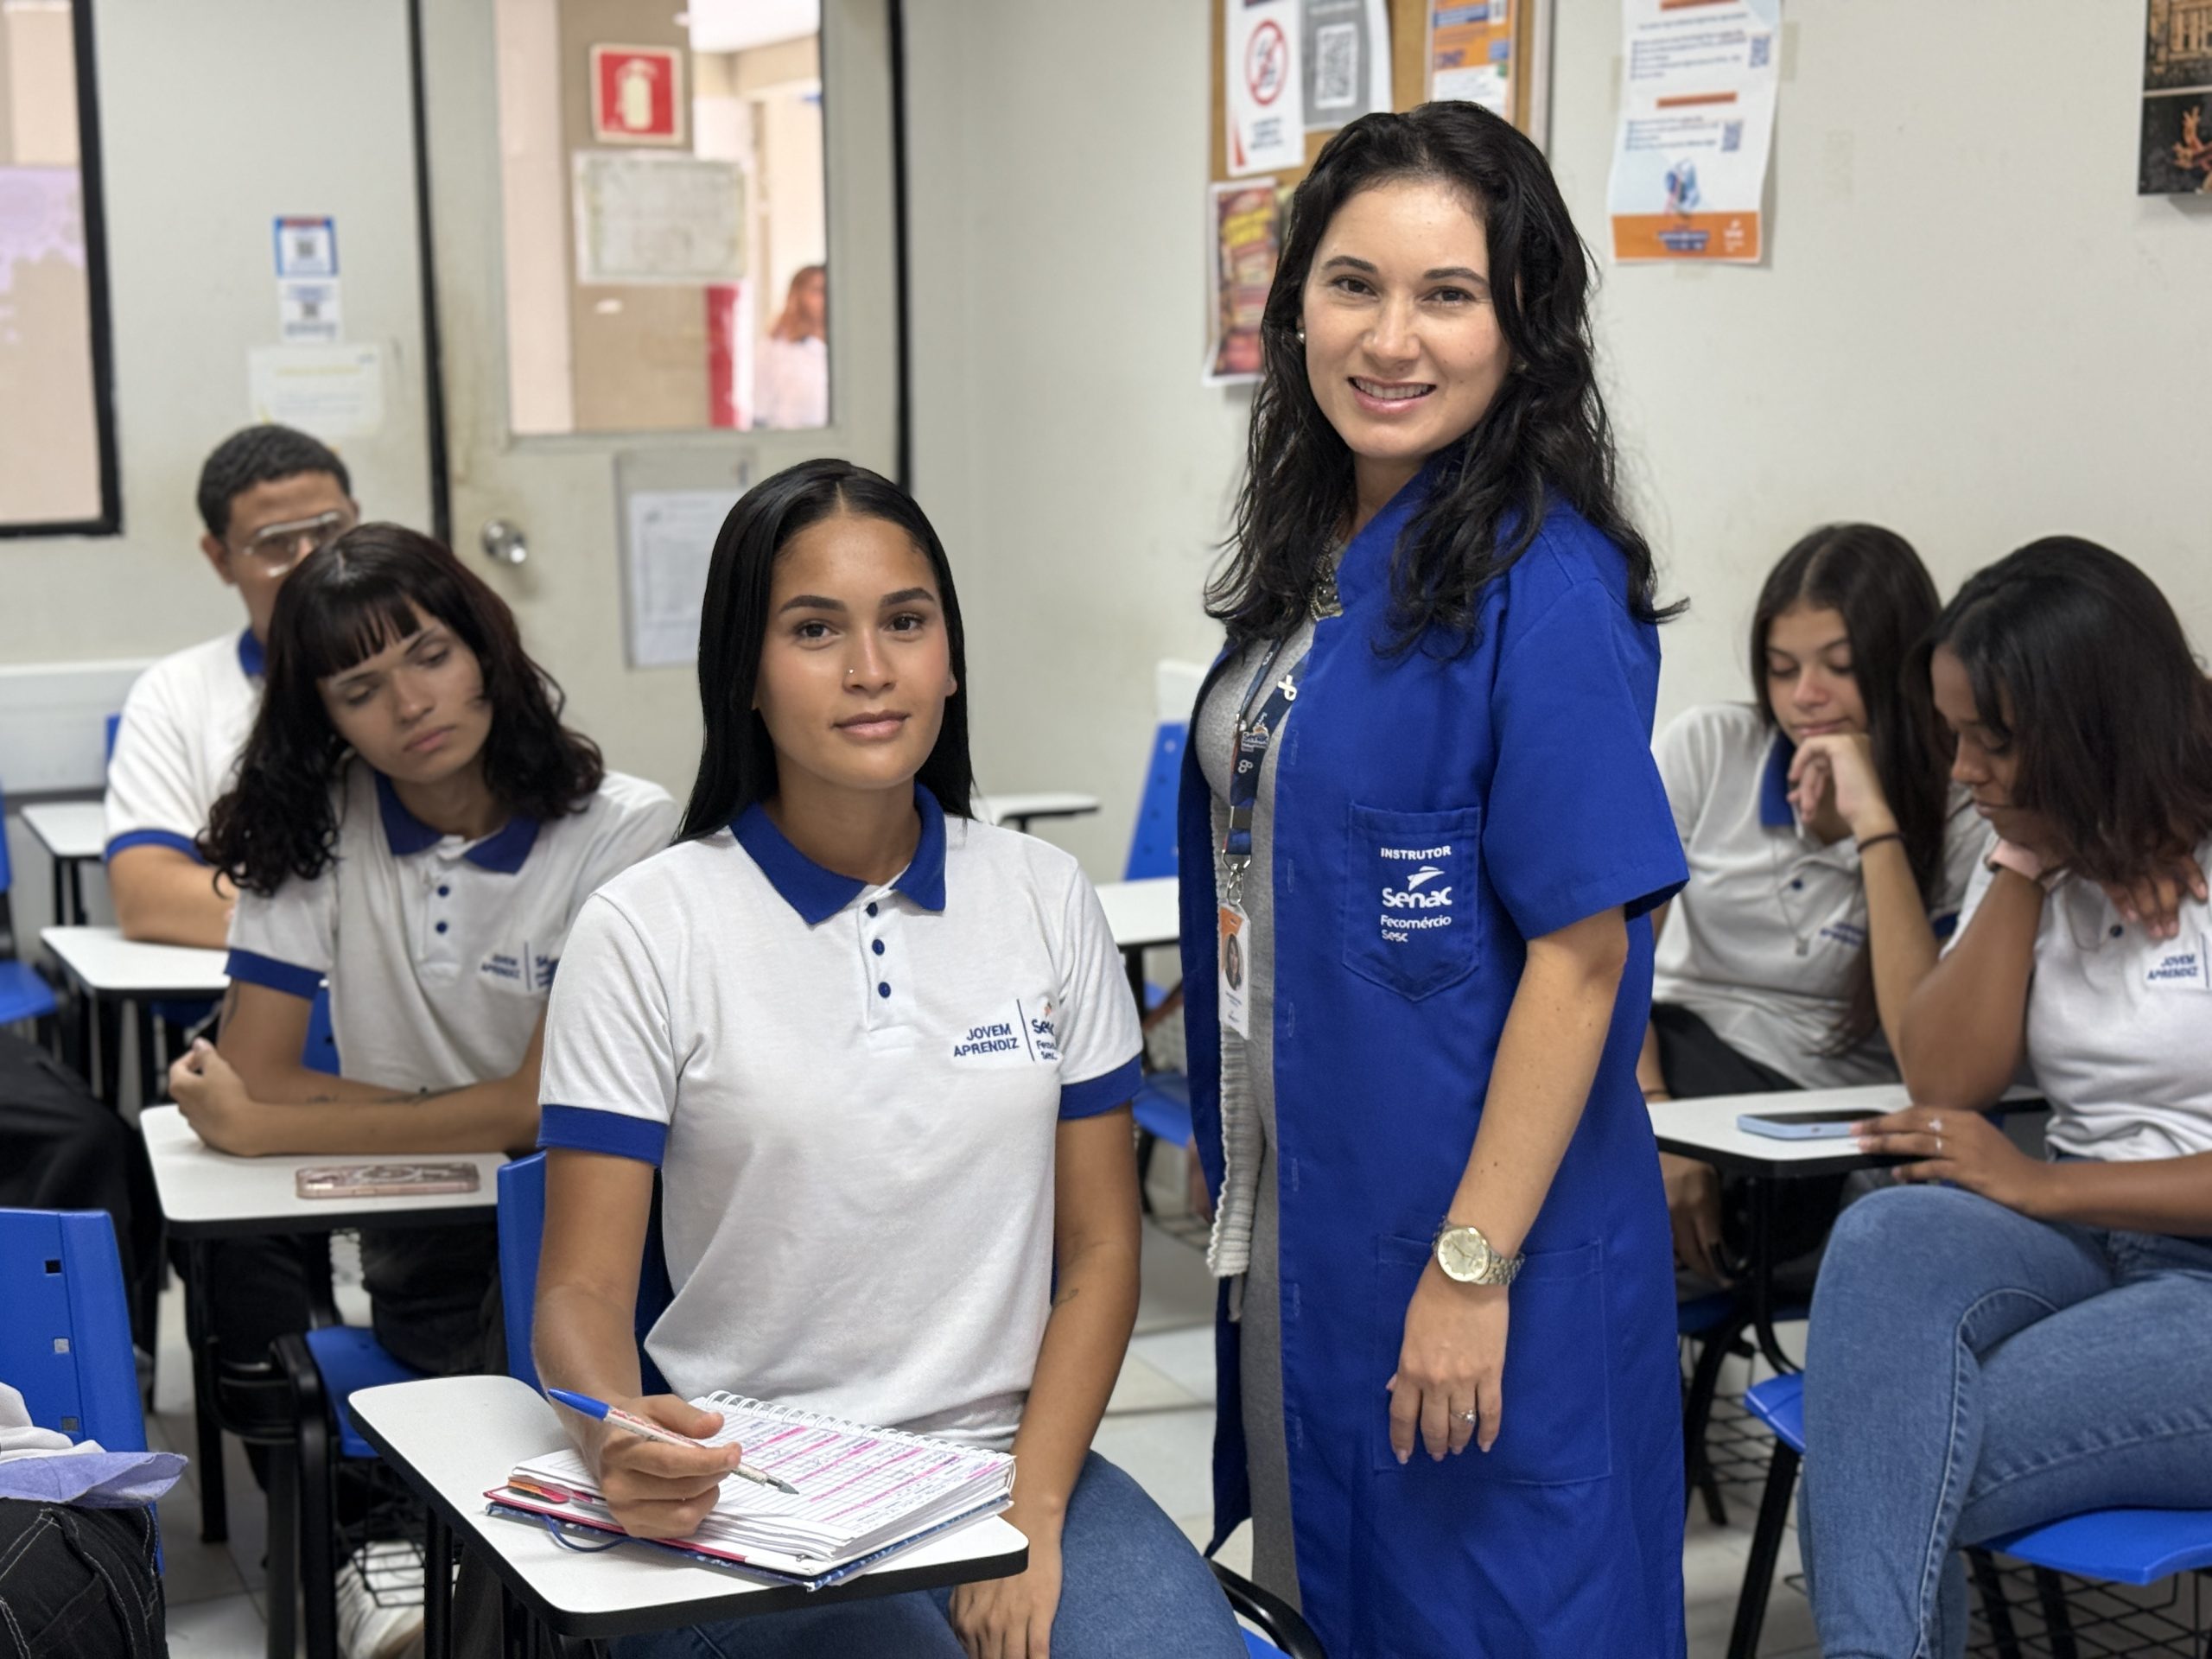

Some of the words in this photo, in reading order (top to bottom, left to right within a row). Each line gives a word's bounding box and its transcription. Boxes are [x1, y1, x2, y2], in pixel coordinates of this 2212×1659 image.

[1381, 845, 1452, 860] INSTRUTOR
[1382, 886, 1452, 908] Senac
[1381, 915, 1452, 929] Fecomércio
[1381, 929, 1408, 943] Sesc
[2160, 953, 2195, 967] JOVEM
[2146, 966, 2198, 980] APRENDIZ
[966, 1023, 1012, 1040] JOVEM
[954, 1038, 1020, 1057] APRENDIZ
